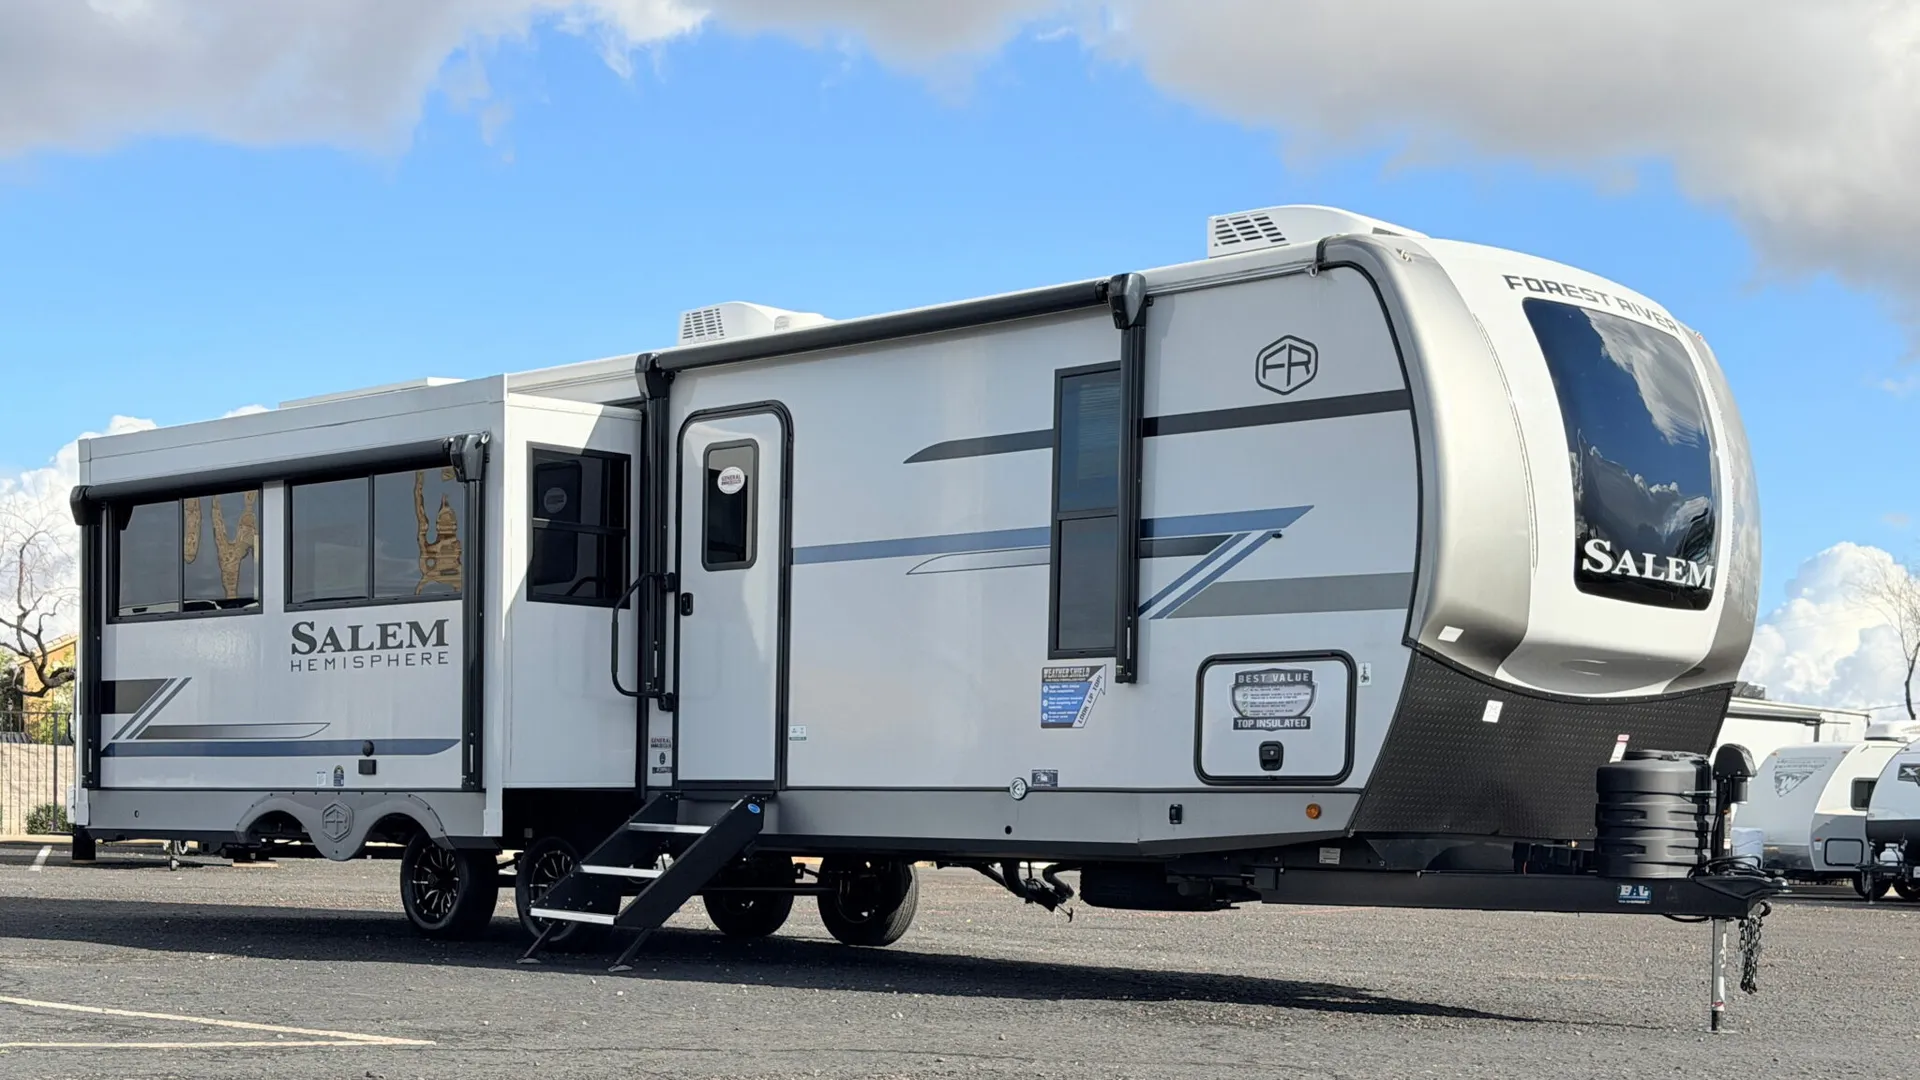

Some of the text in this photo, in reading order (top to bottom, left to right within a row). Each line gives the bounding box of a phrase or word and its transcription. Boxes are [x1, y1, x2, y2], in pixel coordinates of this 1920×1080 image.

[1502, 274, 1680, 335] FOREST RIVER
[1582, 538, 1714, 590] SALEM
[291, 619, 450, 656] SALEM
[290, 651, 450, 673] HEMISPHERE
[1238, 672, 1310, 684] BEST VALUE
[1236, 719, 1308, 728] TOP INSULATED
